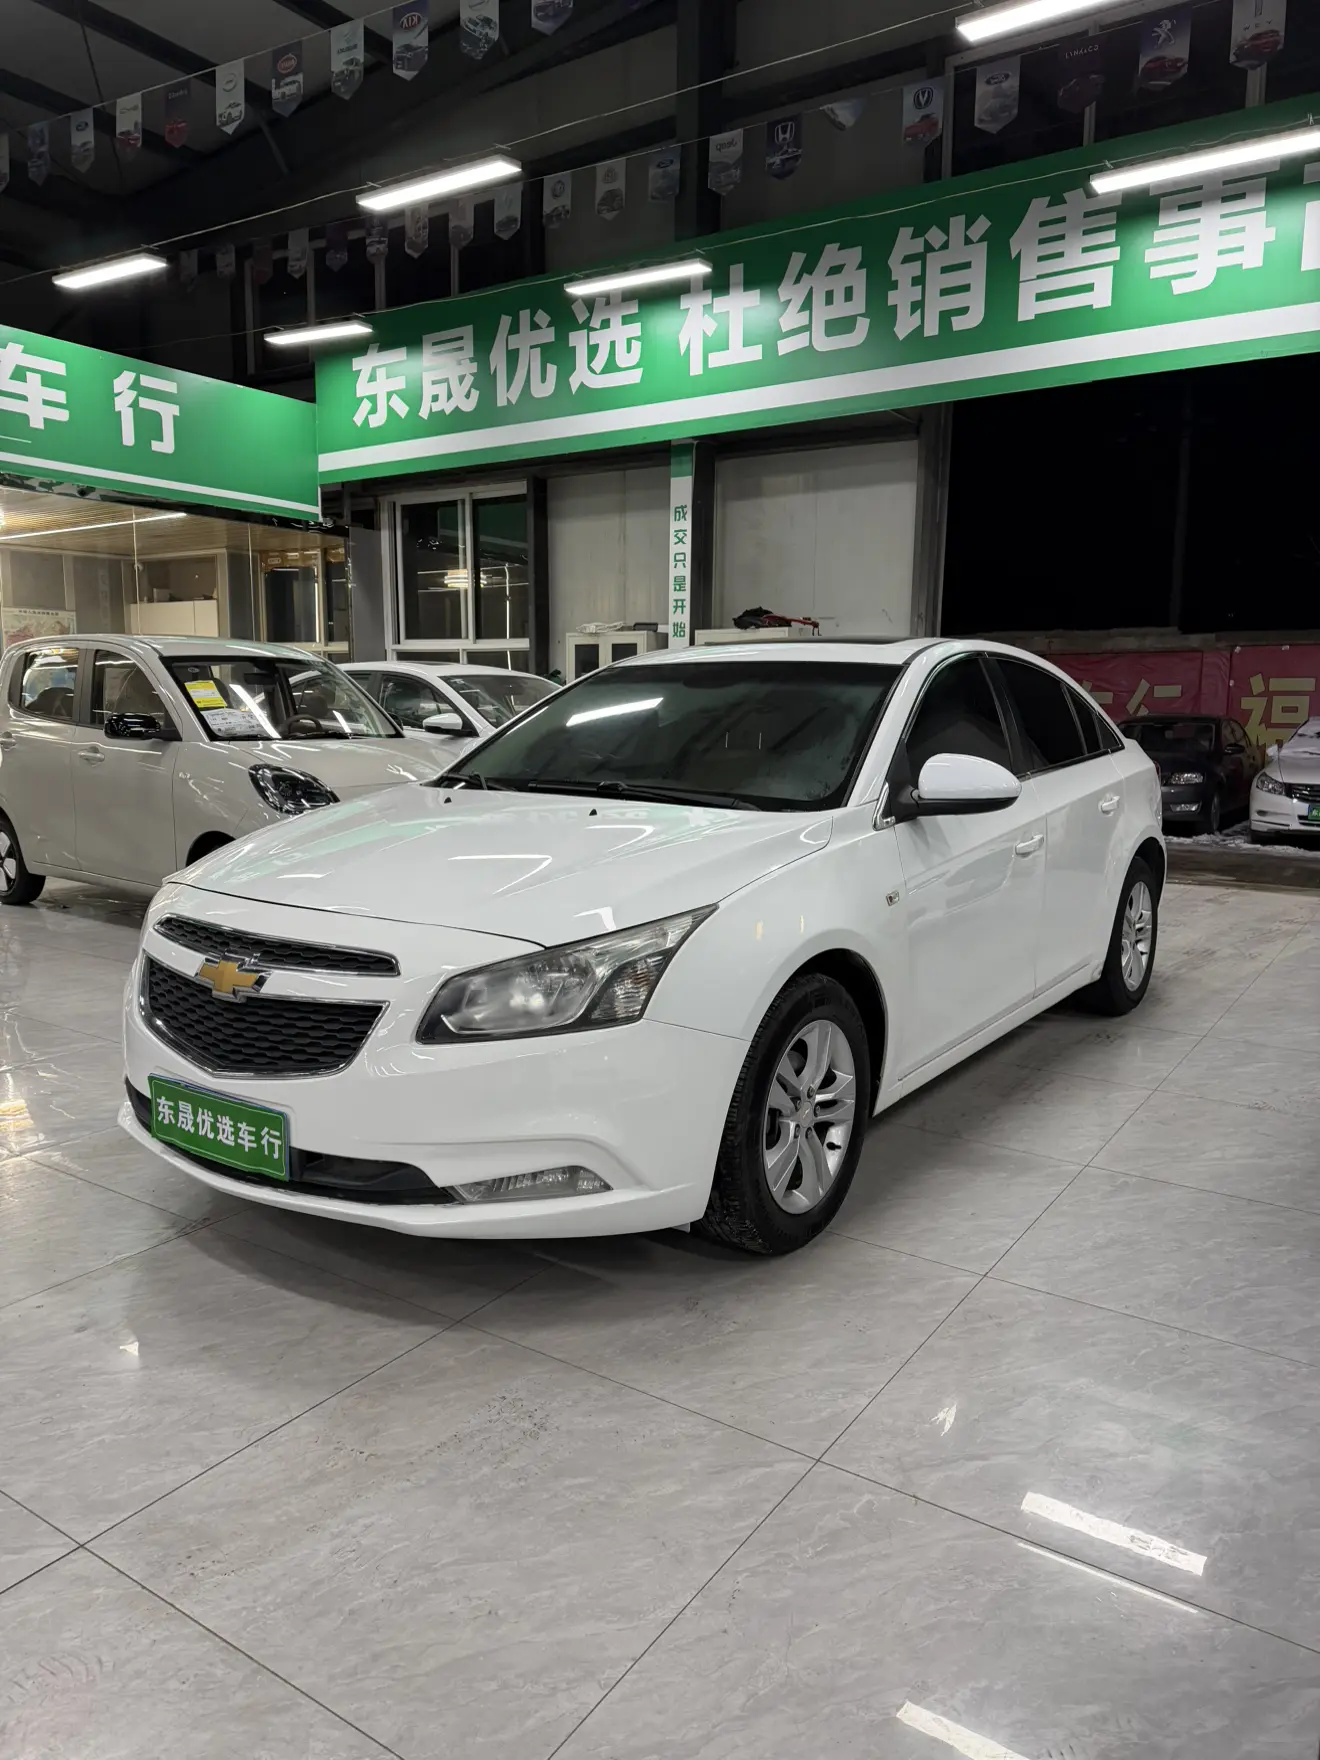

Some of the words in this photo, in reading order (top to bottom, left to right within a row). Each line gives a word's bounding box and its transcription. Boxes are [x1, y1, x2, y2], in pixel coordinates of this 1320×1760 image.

[351, 296, 644, 429] 东晟优选
[677, 160, 1320, 377] 杜绝销售事
[0, 343, 180, 454] 车行
[672, 504, 688, 638] 成交只是开始
[156, 1096, 282, 1159] 东晟优选车行
